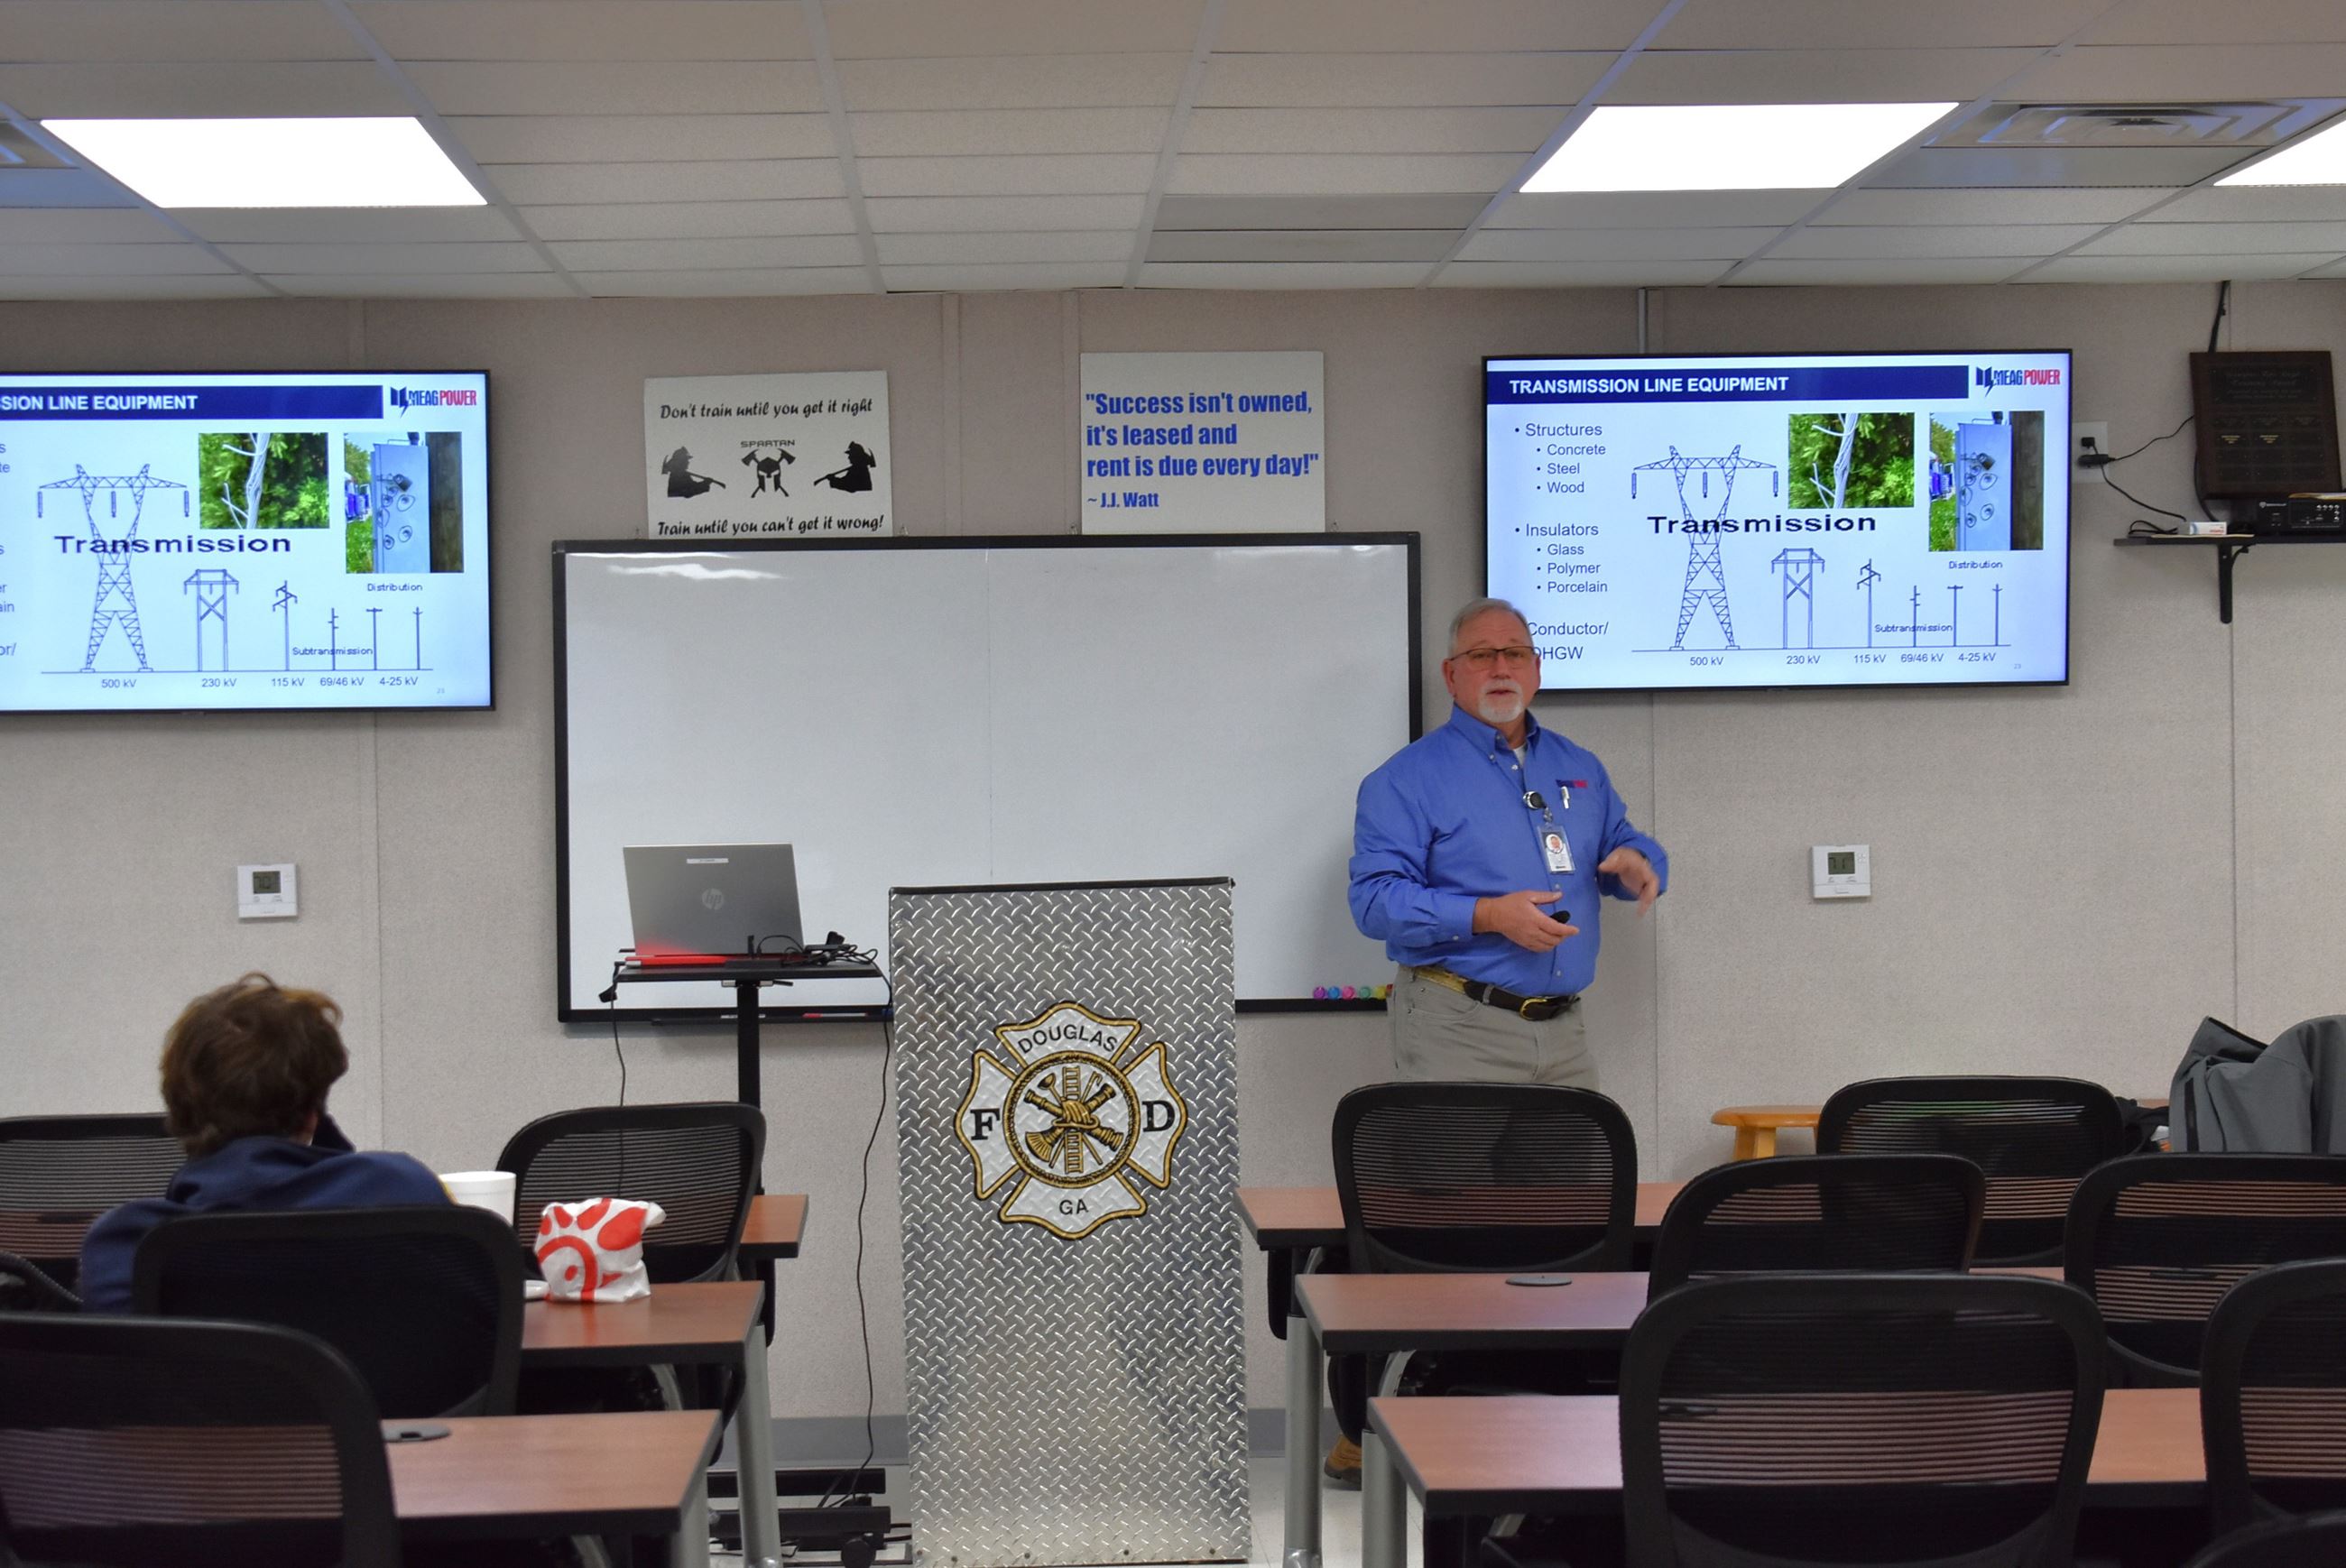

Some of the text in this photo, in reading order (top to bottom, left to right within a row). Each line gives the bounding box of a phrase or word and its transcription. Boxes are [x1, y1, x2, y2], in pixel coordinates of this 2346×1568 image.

[1509, 376, 1789, 394] TRANSMISSION LINE EQUIPMENT
[49, 395, 89, 410] LINE
[93, 394, 199, 410] EQUIPMENT
[660, 398, 873, 419] Don't train until you get it right
[1085, 391, 1313, 415] "Success isn't owned,
[1086, 423, 1238, 447] it's leased and
[1525, 422, 1603, 437] Structures
[740, 439, 796, 448] SPARTAN
[1547, 443, 1606, 457] Concrete
[1086, 453, 1319, 477] rent is due every day!"
[1547, 462, 1581, 475] Steel
[1547, 481, 1584, 493] Wood
[1100, 492, 1121, 508] J.J.
[1122, 492, 1159, 508] Watt
[658, 514, 884, 536] Train until you can't get it wrong!
[1525, 522, 1600, 537] Insulators
[1647, 513, 1877, 534] Transmission
[53, 534, 291, 554] Transmission
[1547, 543, 1585, 556] Glass
[1547, 562, 1602, 577] Polymer
[1948, 560, 2004, 569] Distribution
[366, 582, 423, 592] Distribution
[1547, 581, 1609, 593] Porcelain
[1528, 621, 1610, 636] Conductor/
[1874, 623, 1953, 633] Subtransmission
[291, 646, 374, 656] Subtransmission
[1958, 652, 1997, 662] 4-25 kV
[1689, 657, 1724, 667] 500 kV
[1787, 655, 1821, 665] 230 kV
[1854, 654, 1886, 664] 115 kV
[1900, 653, 1944, 663] 69/46 kV
[101, 678, 137, 688] 500 kV
[201, 677, 237, 687] 230 kV
[271, 678, 305, 687] 115 kV
[319, 678, 365, 687] 69/46 kV
[379, 677, 419, 686] 4-25 kV
[1018, 1023, 1118, 1054] DOUGLAS
[970, 1100, 1175, 1140] F D
[1058, 1198, 1089, 1215] GA
